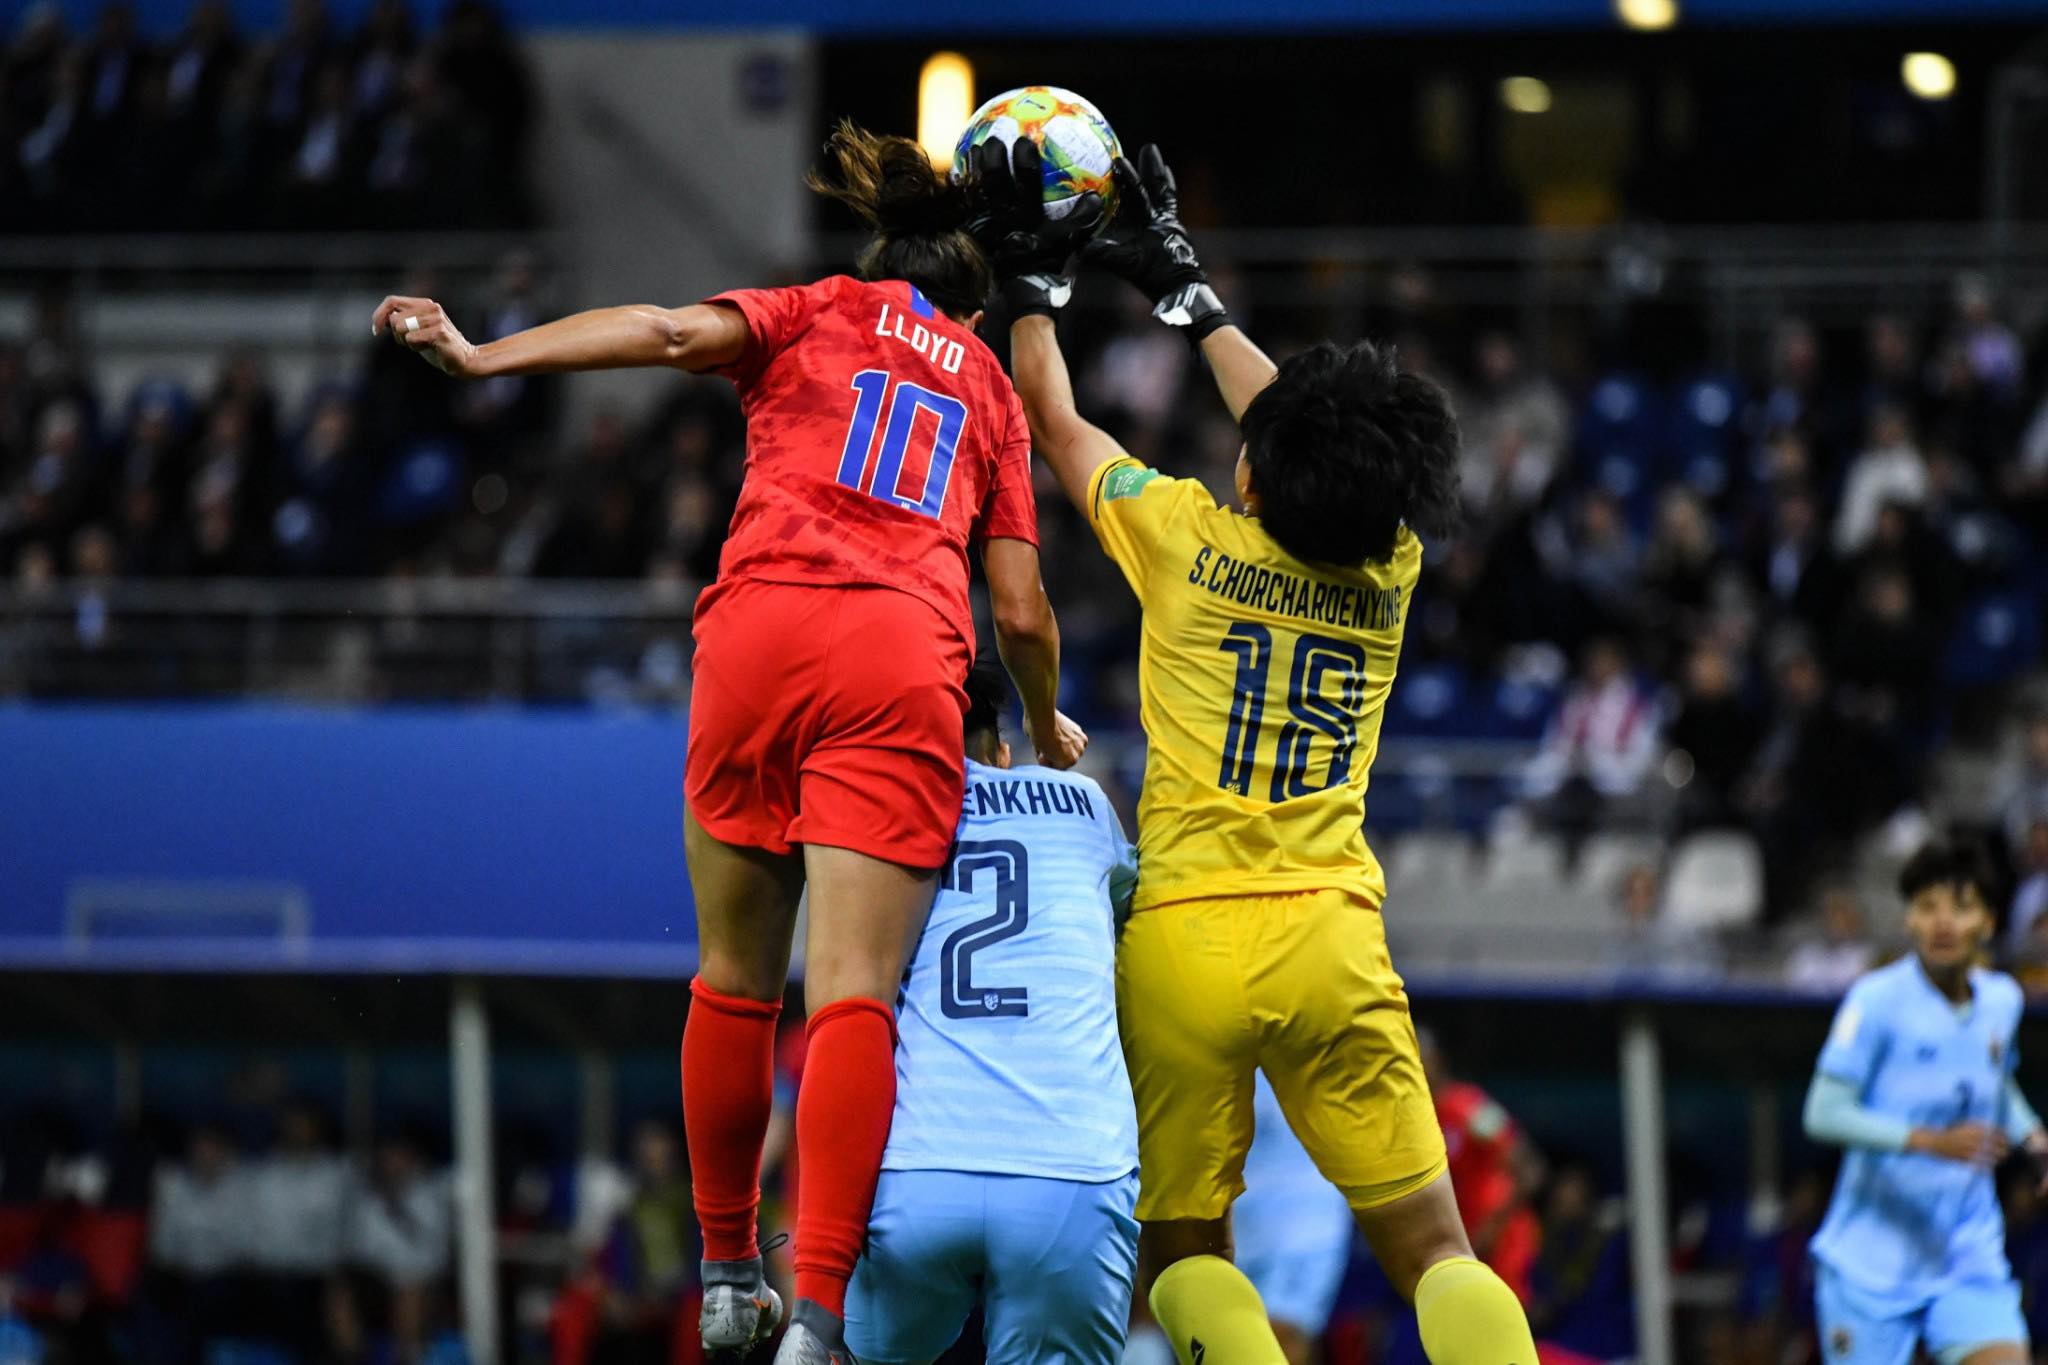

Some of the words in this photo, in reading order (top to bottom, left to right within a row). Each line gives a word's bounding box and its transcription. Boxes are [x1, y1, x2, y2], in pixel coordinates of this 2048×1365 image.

[876, 304, 965, 374] LLOYD
[836, 368, 968, 520] 10
[1188, 546, 1402, 630] S.CHORCHAROENYING
[1218, 620, 1367, 804] 18
[940, 840, 1029, 1019] 2
